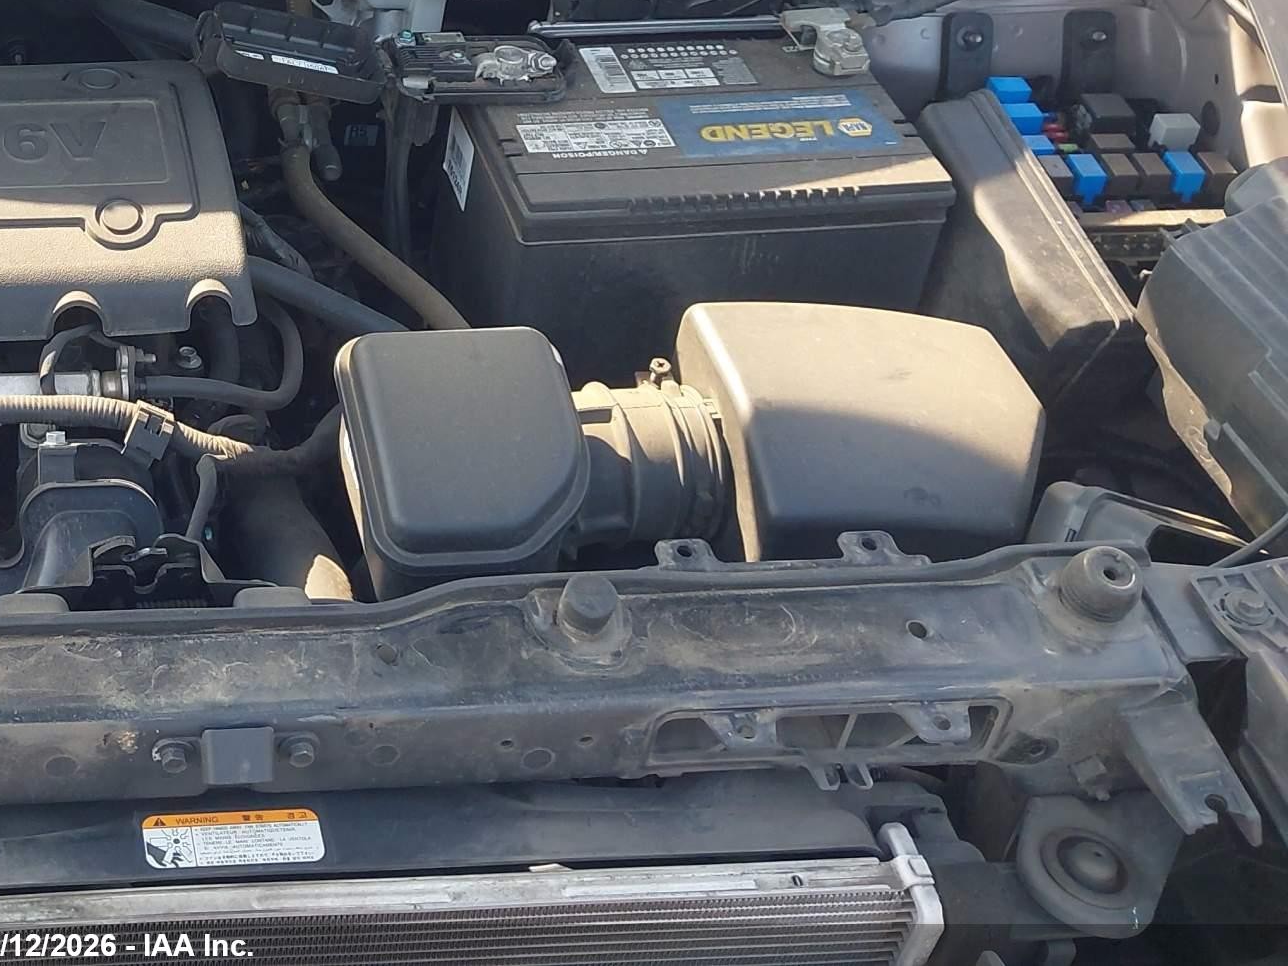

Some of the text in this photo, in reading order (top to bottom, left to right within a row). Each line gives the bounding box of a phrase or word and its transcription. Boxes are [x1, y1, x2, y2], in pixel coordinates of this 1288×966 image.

[700, 119, 834, 143] LEGEND
[551, 148, 638, 160] DANGER/POISON
[175, 815, 219, 825] WARNING
